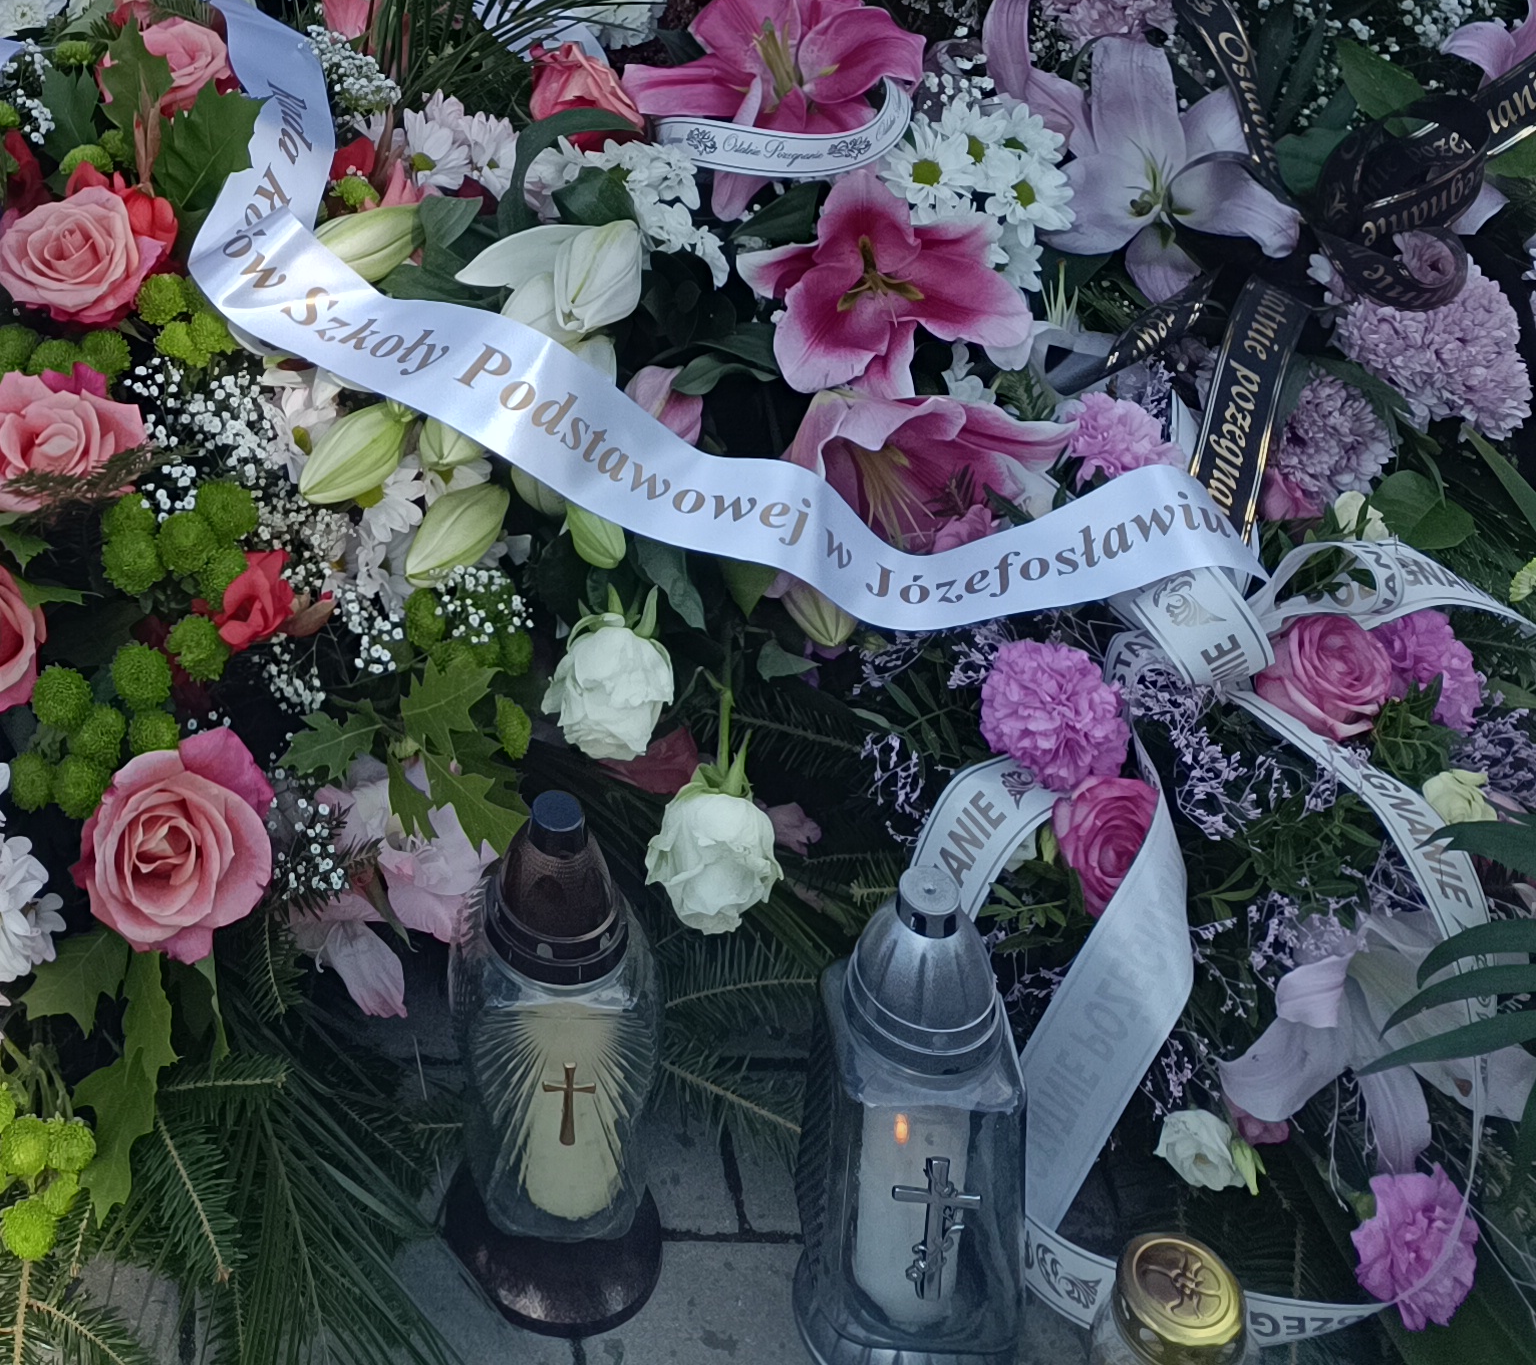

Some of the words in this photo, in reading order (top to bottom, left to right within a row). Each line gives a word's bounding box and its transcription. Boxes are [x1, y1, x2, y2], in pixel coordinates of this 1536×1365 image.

[281, 286, 449, 376] Szkoły
[453, 342, 812, 547] Podstawowej
[825, 526, 853, 569] w
[865, 490, 1232, 605] Józefosławiu
[1362, 773, 1475, 910] GNANIE
